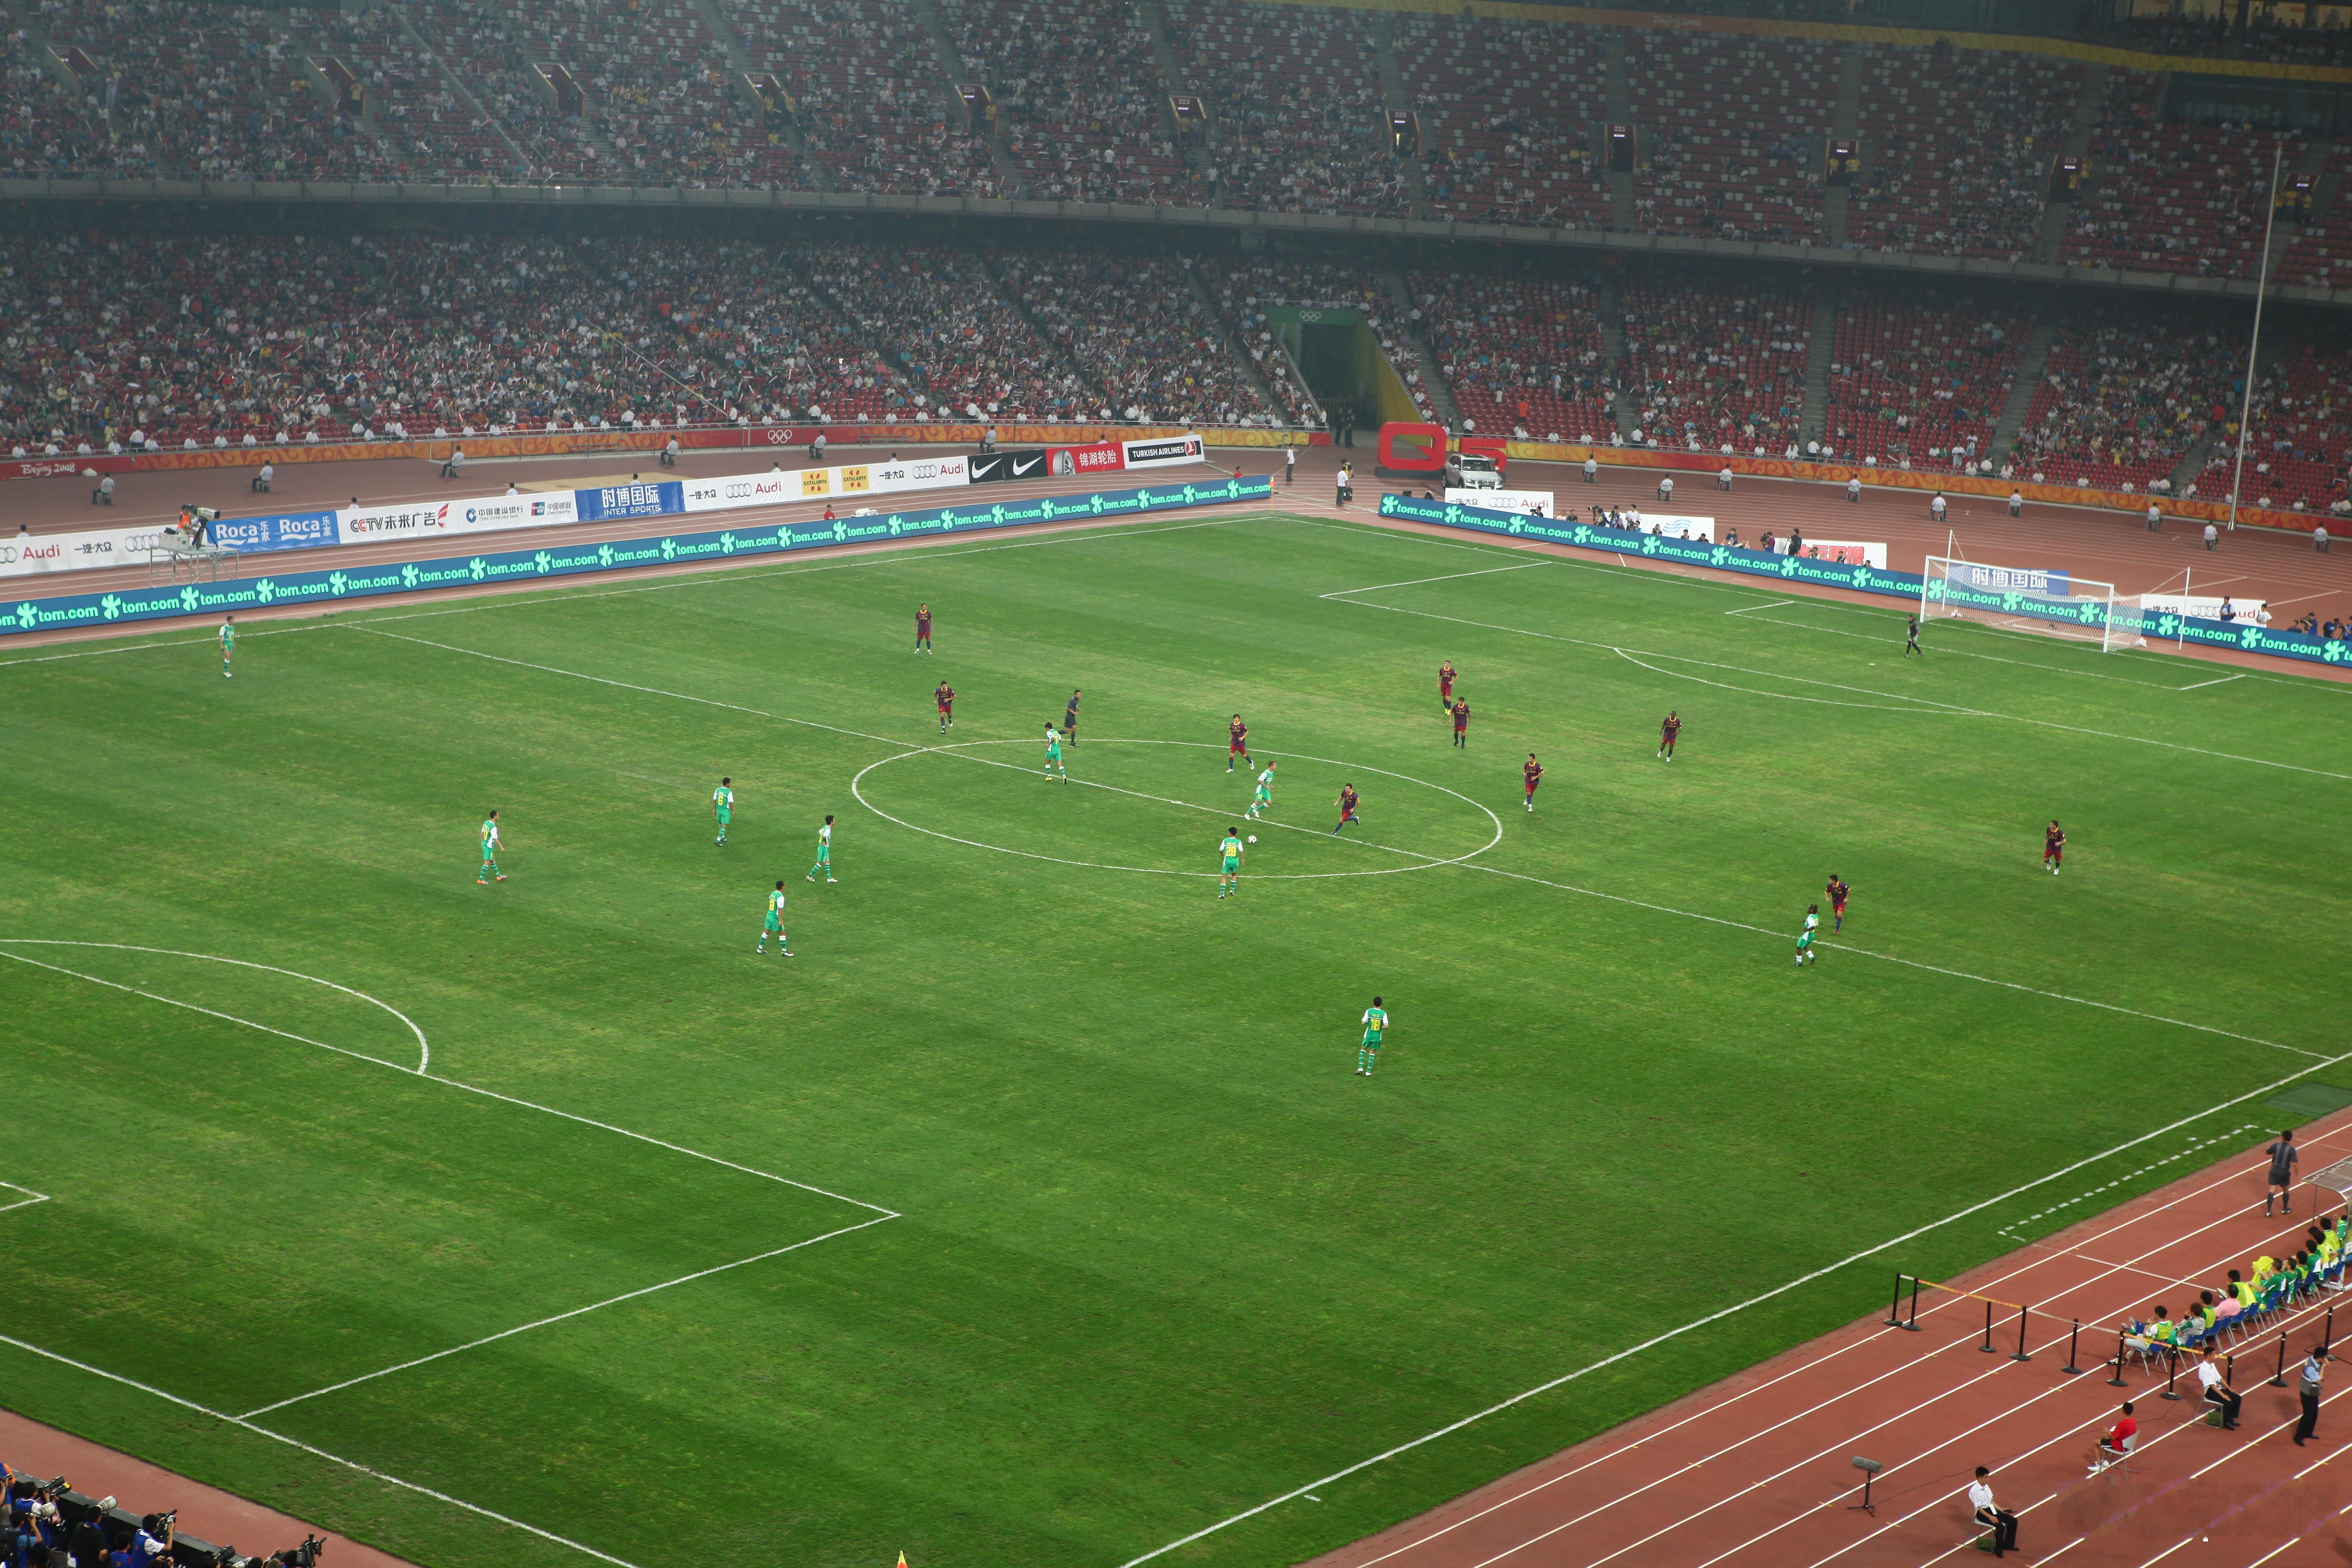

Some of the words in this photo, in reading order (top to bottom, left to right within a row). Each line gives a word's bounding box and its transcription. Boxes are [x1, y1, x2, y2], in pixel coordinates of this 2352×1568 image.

[1078, 450, 1117, 467] 锦湖轮胎
[1132, 449, 1158, 459] TURKISH
[1158, 446, 1185, 456] AIRLINES
[20, 463, 52, 477] Beijing
[53, 463, 75, 473] 2008
[940, 463, 964, 475] Audi
[755, 482, 782, 494] Audi
[601, 485, 660, 508] 时博国际
[1521, 499, 1549, 508] Audi
[479, 505, 523, 516] 中国建设银行
[547, 502, 572, 510] 中国银联
[604, 508, 627, 516] INTER
[630, 505, 660, 514] SPORTS
[279, 518, 320, 534] Roca
[322, 516, 332, 537] 乐家
[350, 517, 384, 532] CCTV
[384, 511, 436, 530] 未来广告
[215, 524, 258, 539] Roca
[260, 521, 271, 543] 乐家
[23, 544, 61, 560] Audi
[38, 606, 98, 622] tom.com
[122, 598, 180, 614] tom.com
[200, 591, 255, 605] tom.com
[275, 583, 329, 597] tom.com
[348, 576, 400, 590] tom.com
[419, 568, 469, 582] tom.com
[487, 562, 534, 575] tom.com
[551, 555, 598, 568] tom.com
[614, 549, 659, 562] tom.com
[676, 543, 720, 555] tom.com
[735, 536, 778, 549] tom.com
[792, 531, 833, 543] tom.com
[847, 525, 887, 536] tom.com
[902, 519, 941, 531] tom.com
[954, 514, 992, 525] tom.com
[1004, 509, 1042, 520] tom.com
[1054, 504, 1090, 515] tom.com
[1103, 499, 1138, 509] tom.com
[1150, 494, 1184, 504] tom.com
[1195, 489, 1228, 500] tom.com
[1238, 485, 1270, 495] tom.com
[1397, 504, 1443, 518] tom.com
[1460, 514, 1507, 528] tom.com
[1524, 524, 1572, 539] tom.com
[1590, 534, 1639, 549] tom.com
[1659, 544, 1709, 560] tom.com
[1728, 555, 1779, 571] tom.com
[1798, 566, 1850, 582] tom.com
[1870, 577, 1924, 593] tom.com
[1945, 588, 2001, 606] tom.com
[2021, 600, 2077, 618] tom.com
[2177, 624, 2236, 642] tom.com
[2261, 637, 2321, 656] tom.com
